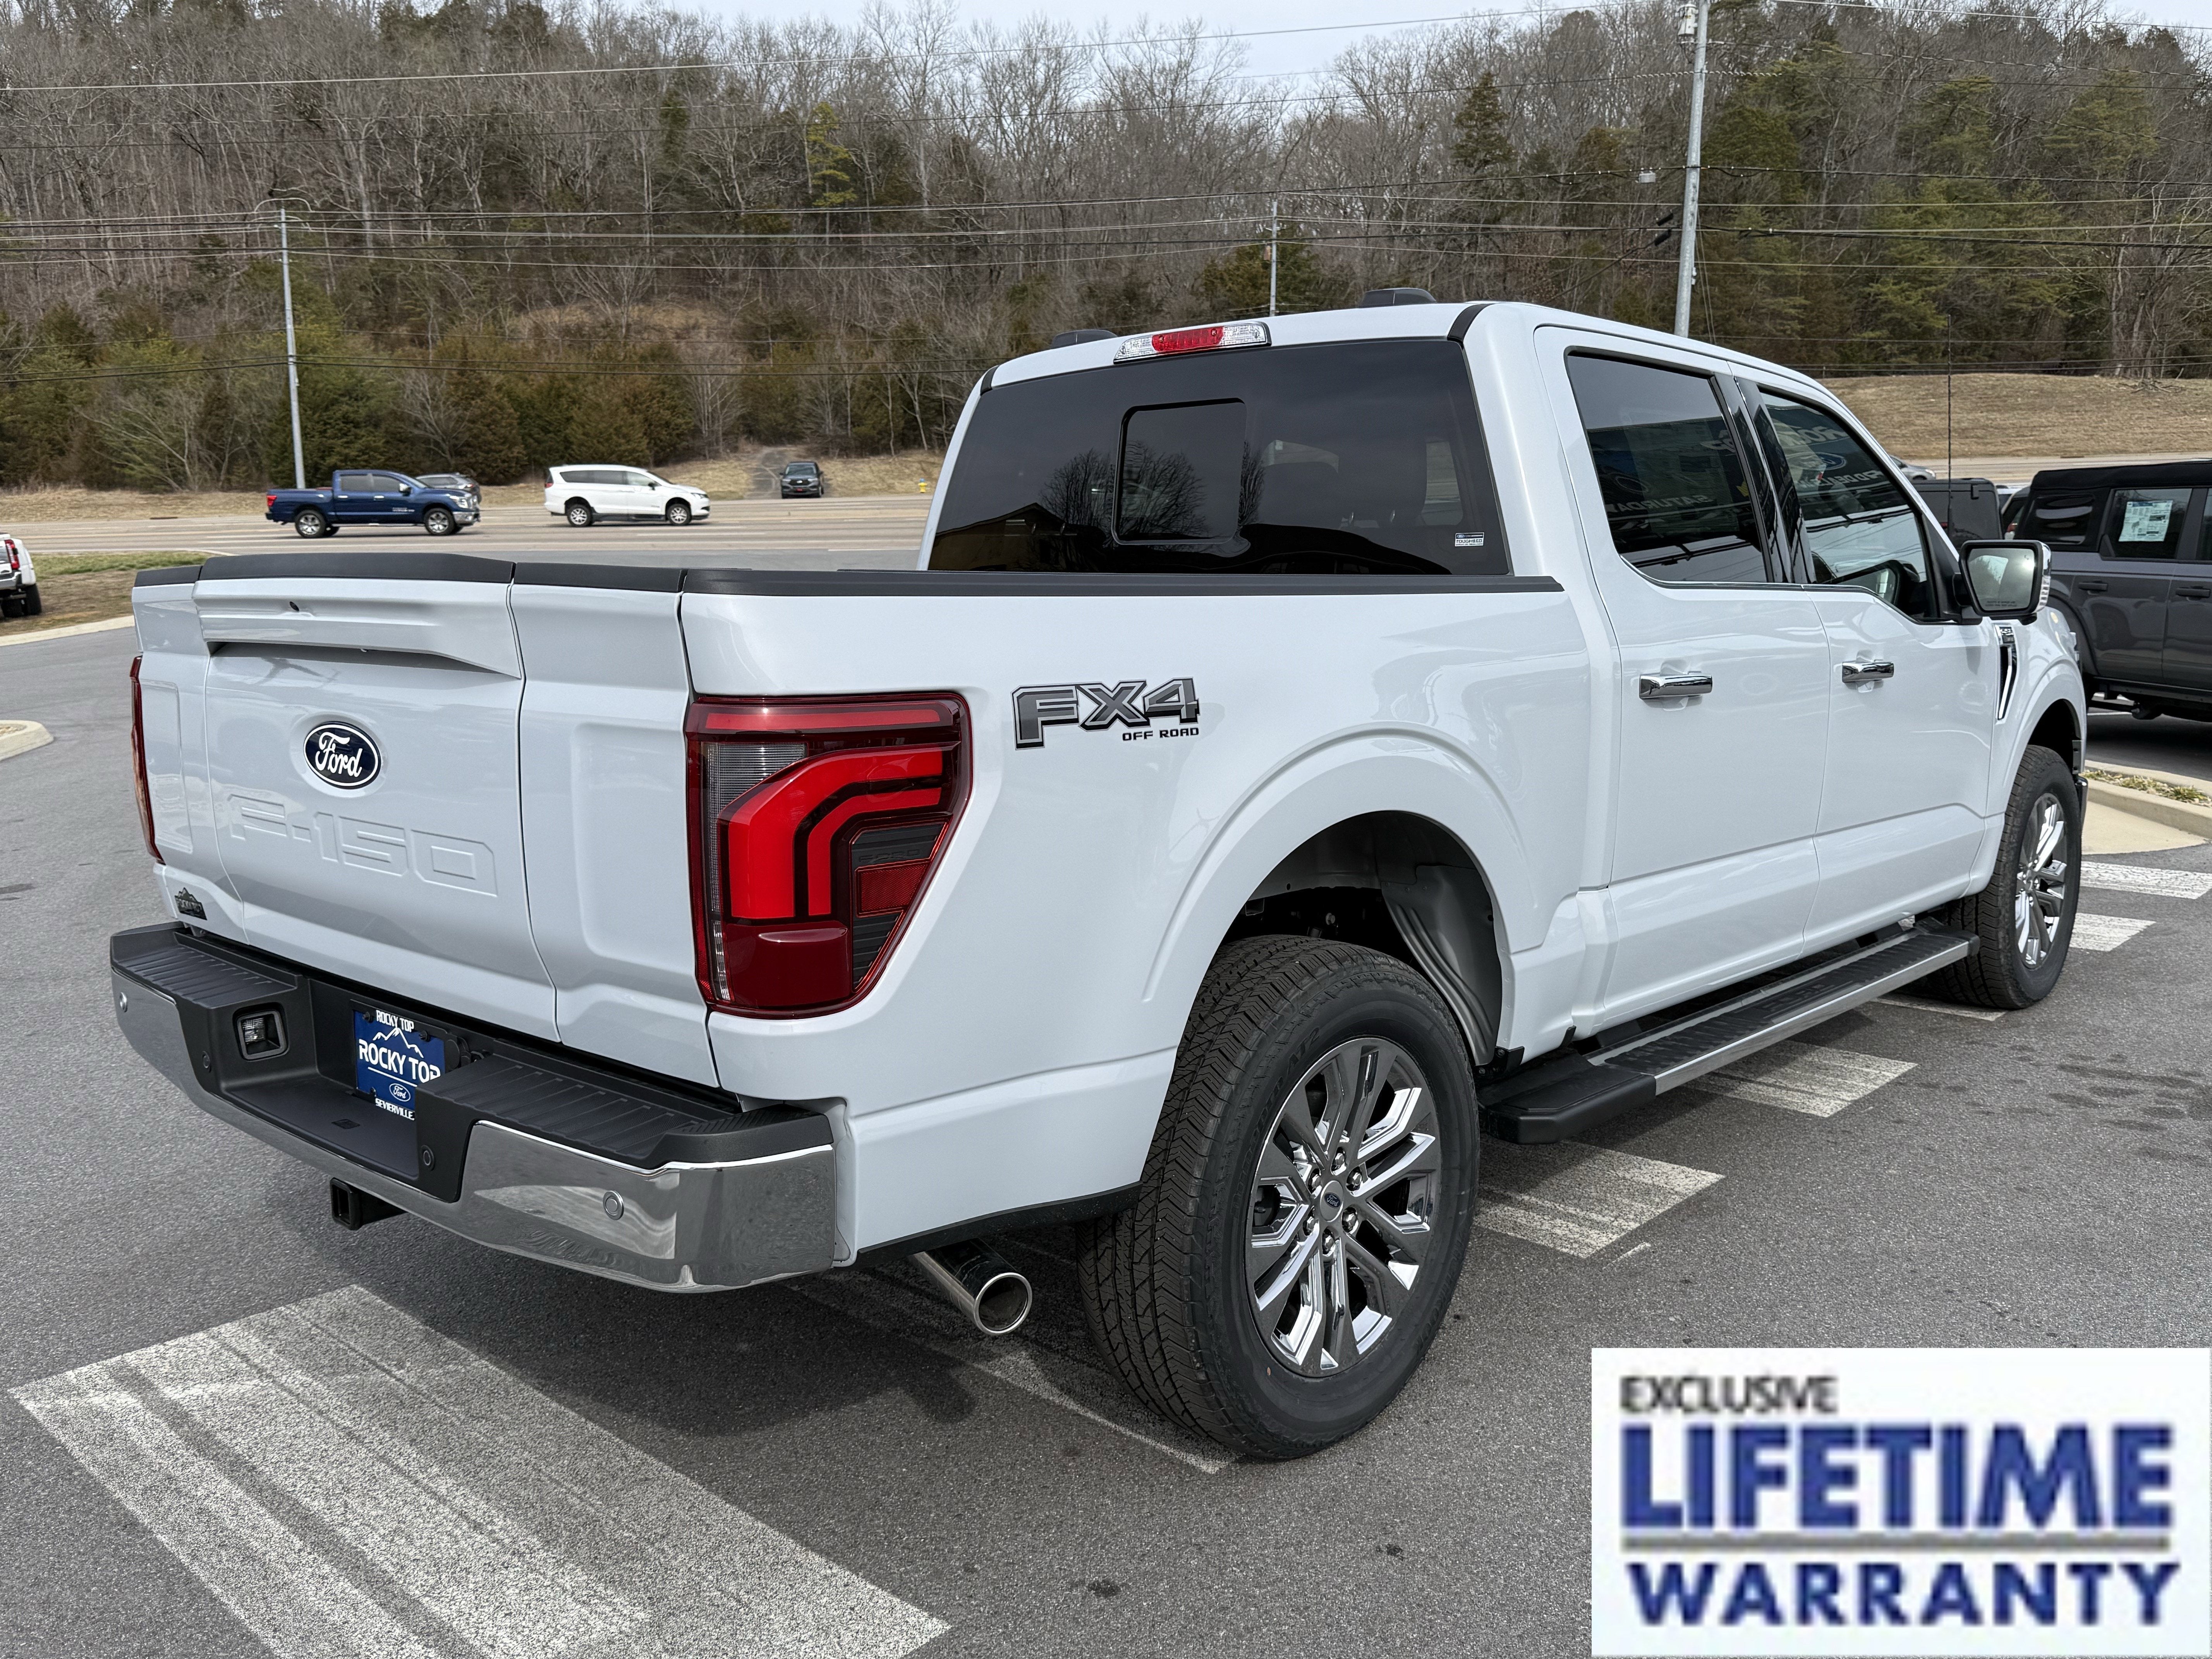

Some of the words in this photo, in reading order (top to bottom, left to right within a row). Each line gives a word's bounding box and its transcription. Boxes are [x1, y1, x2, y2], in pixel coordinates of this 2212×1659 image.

[1011, 677, 1200, 750] FX4
[1123, 731, 1153, 741] OFF
[1159, 728, 1199, 738] ROAD
[315, 732, 362, 778] Ford
[228, 794, 498, 897] F-150
[376, 1010, 398, 1028] ROCKY
[400, 1018, 414, 1033] TOP
[359, 1039, 406, 1075] ROCKY
[409, 1057, 441, 1084] TOP
[393, 1085, 406, 1099] Ford
[375, 1098, 415, 1121] SEVIERVILLE
[1326, 1194, 1339, 1207] Ford
